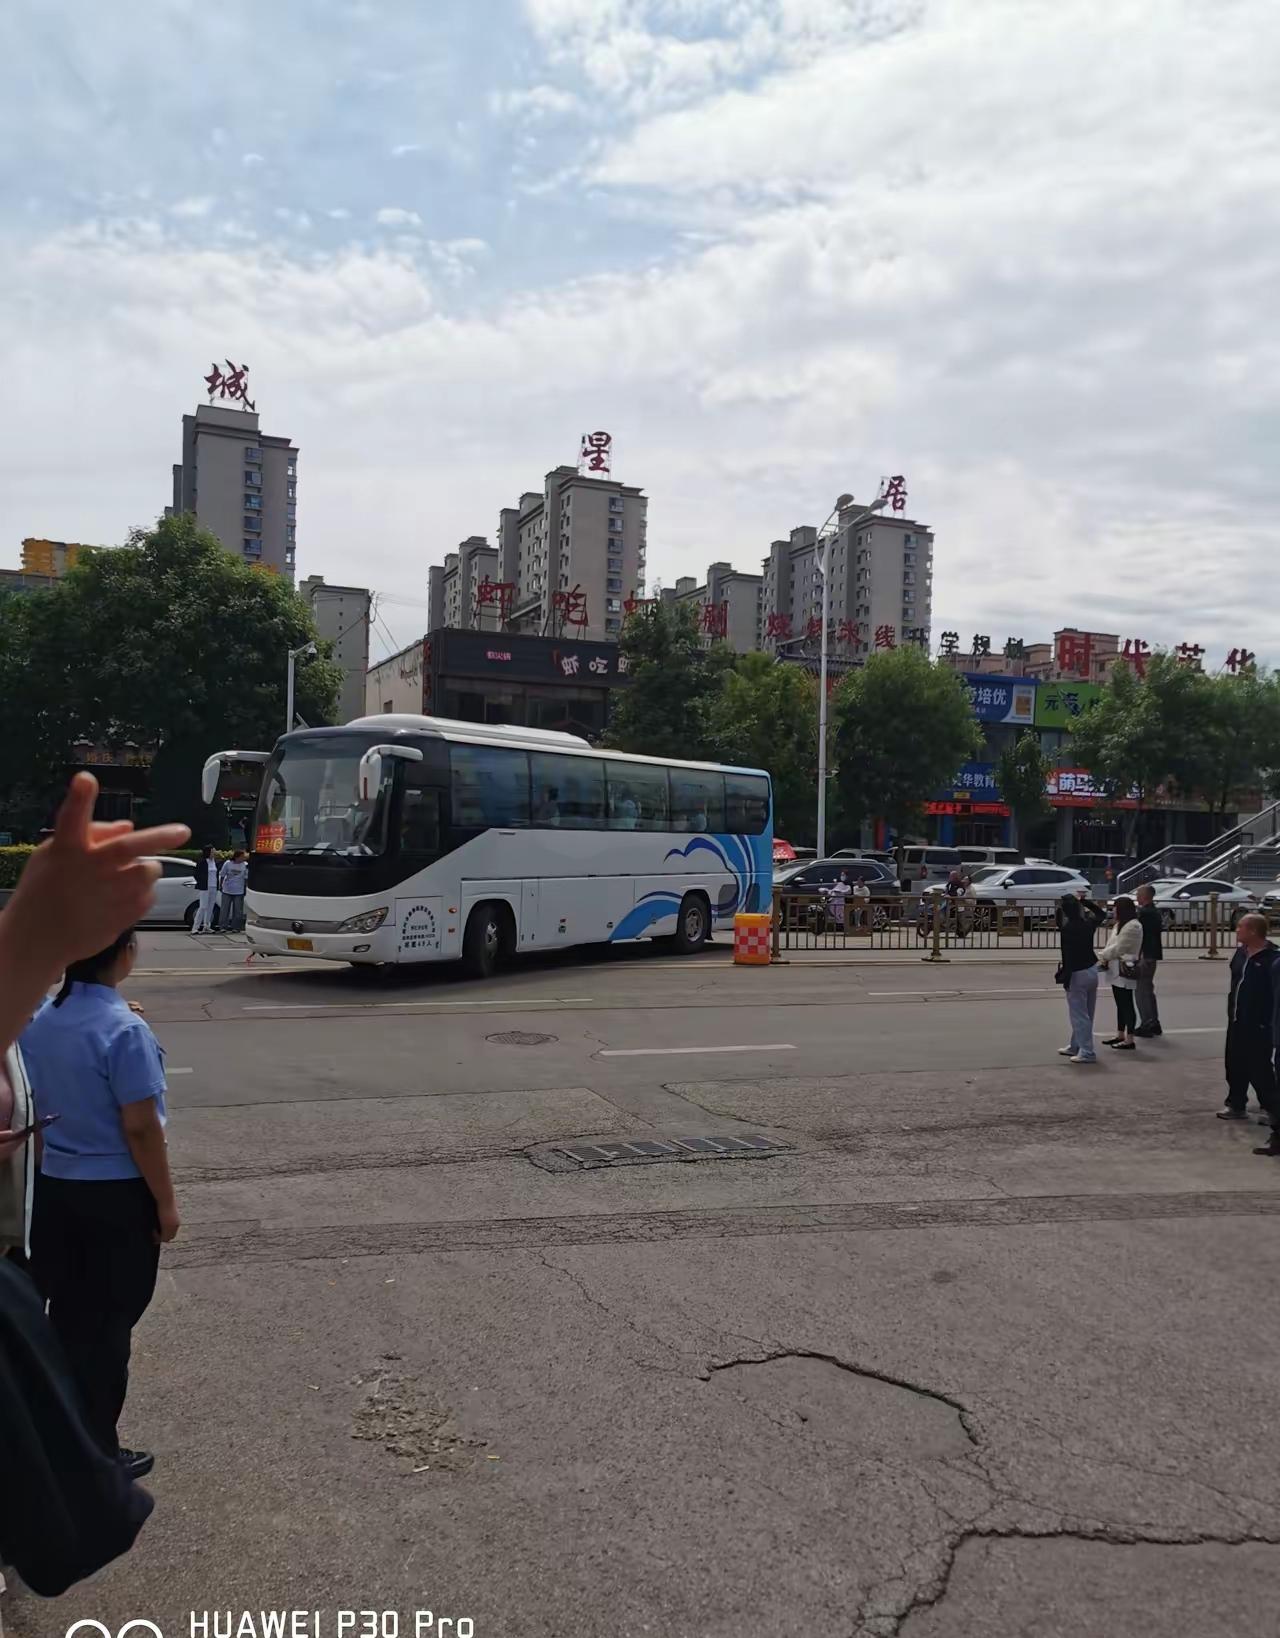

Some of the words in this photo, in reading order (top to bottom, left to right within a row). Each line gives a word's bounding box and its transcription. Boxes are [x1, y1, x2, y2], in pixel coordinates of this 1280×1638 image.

[204, 359, 255, 411] 城
[581, 431, 612, 473] 星
[880, 475, 908, 511] 居
